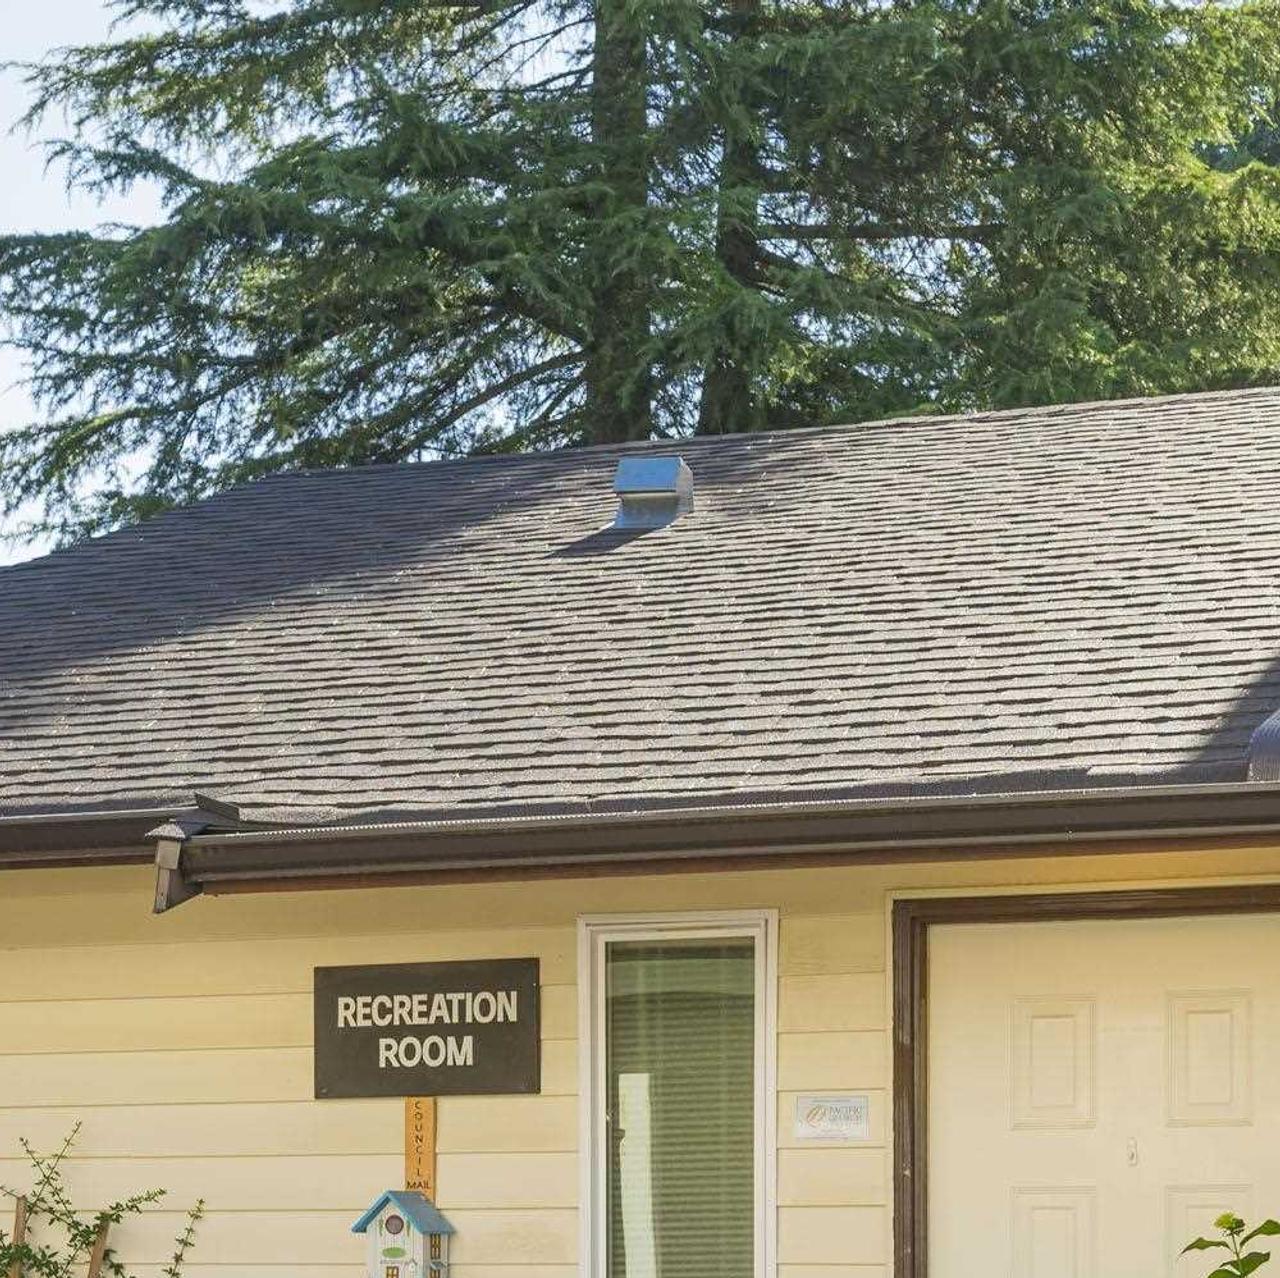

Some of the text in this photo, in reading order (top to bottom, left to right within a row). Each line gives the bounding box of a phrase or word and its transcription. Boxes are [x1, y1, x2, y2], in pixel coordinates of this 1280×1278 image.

[337, 991, 518, 1028] RECREATION
[378, 1035, 474, 1068] ROOM
[414, 1100, 423, 1177] COUNCIL
[406, 1181, 431, 1190] MAIL
